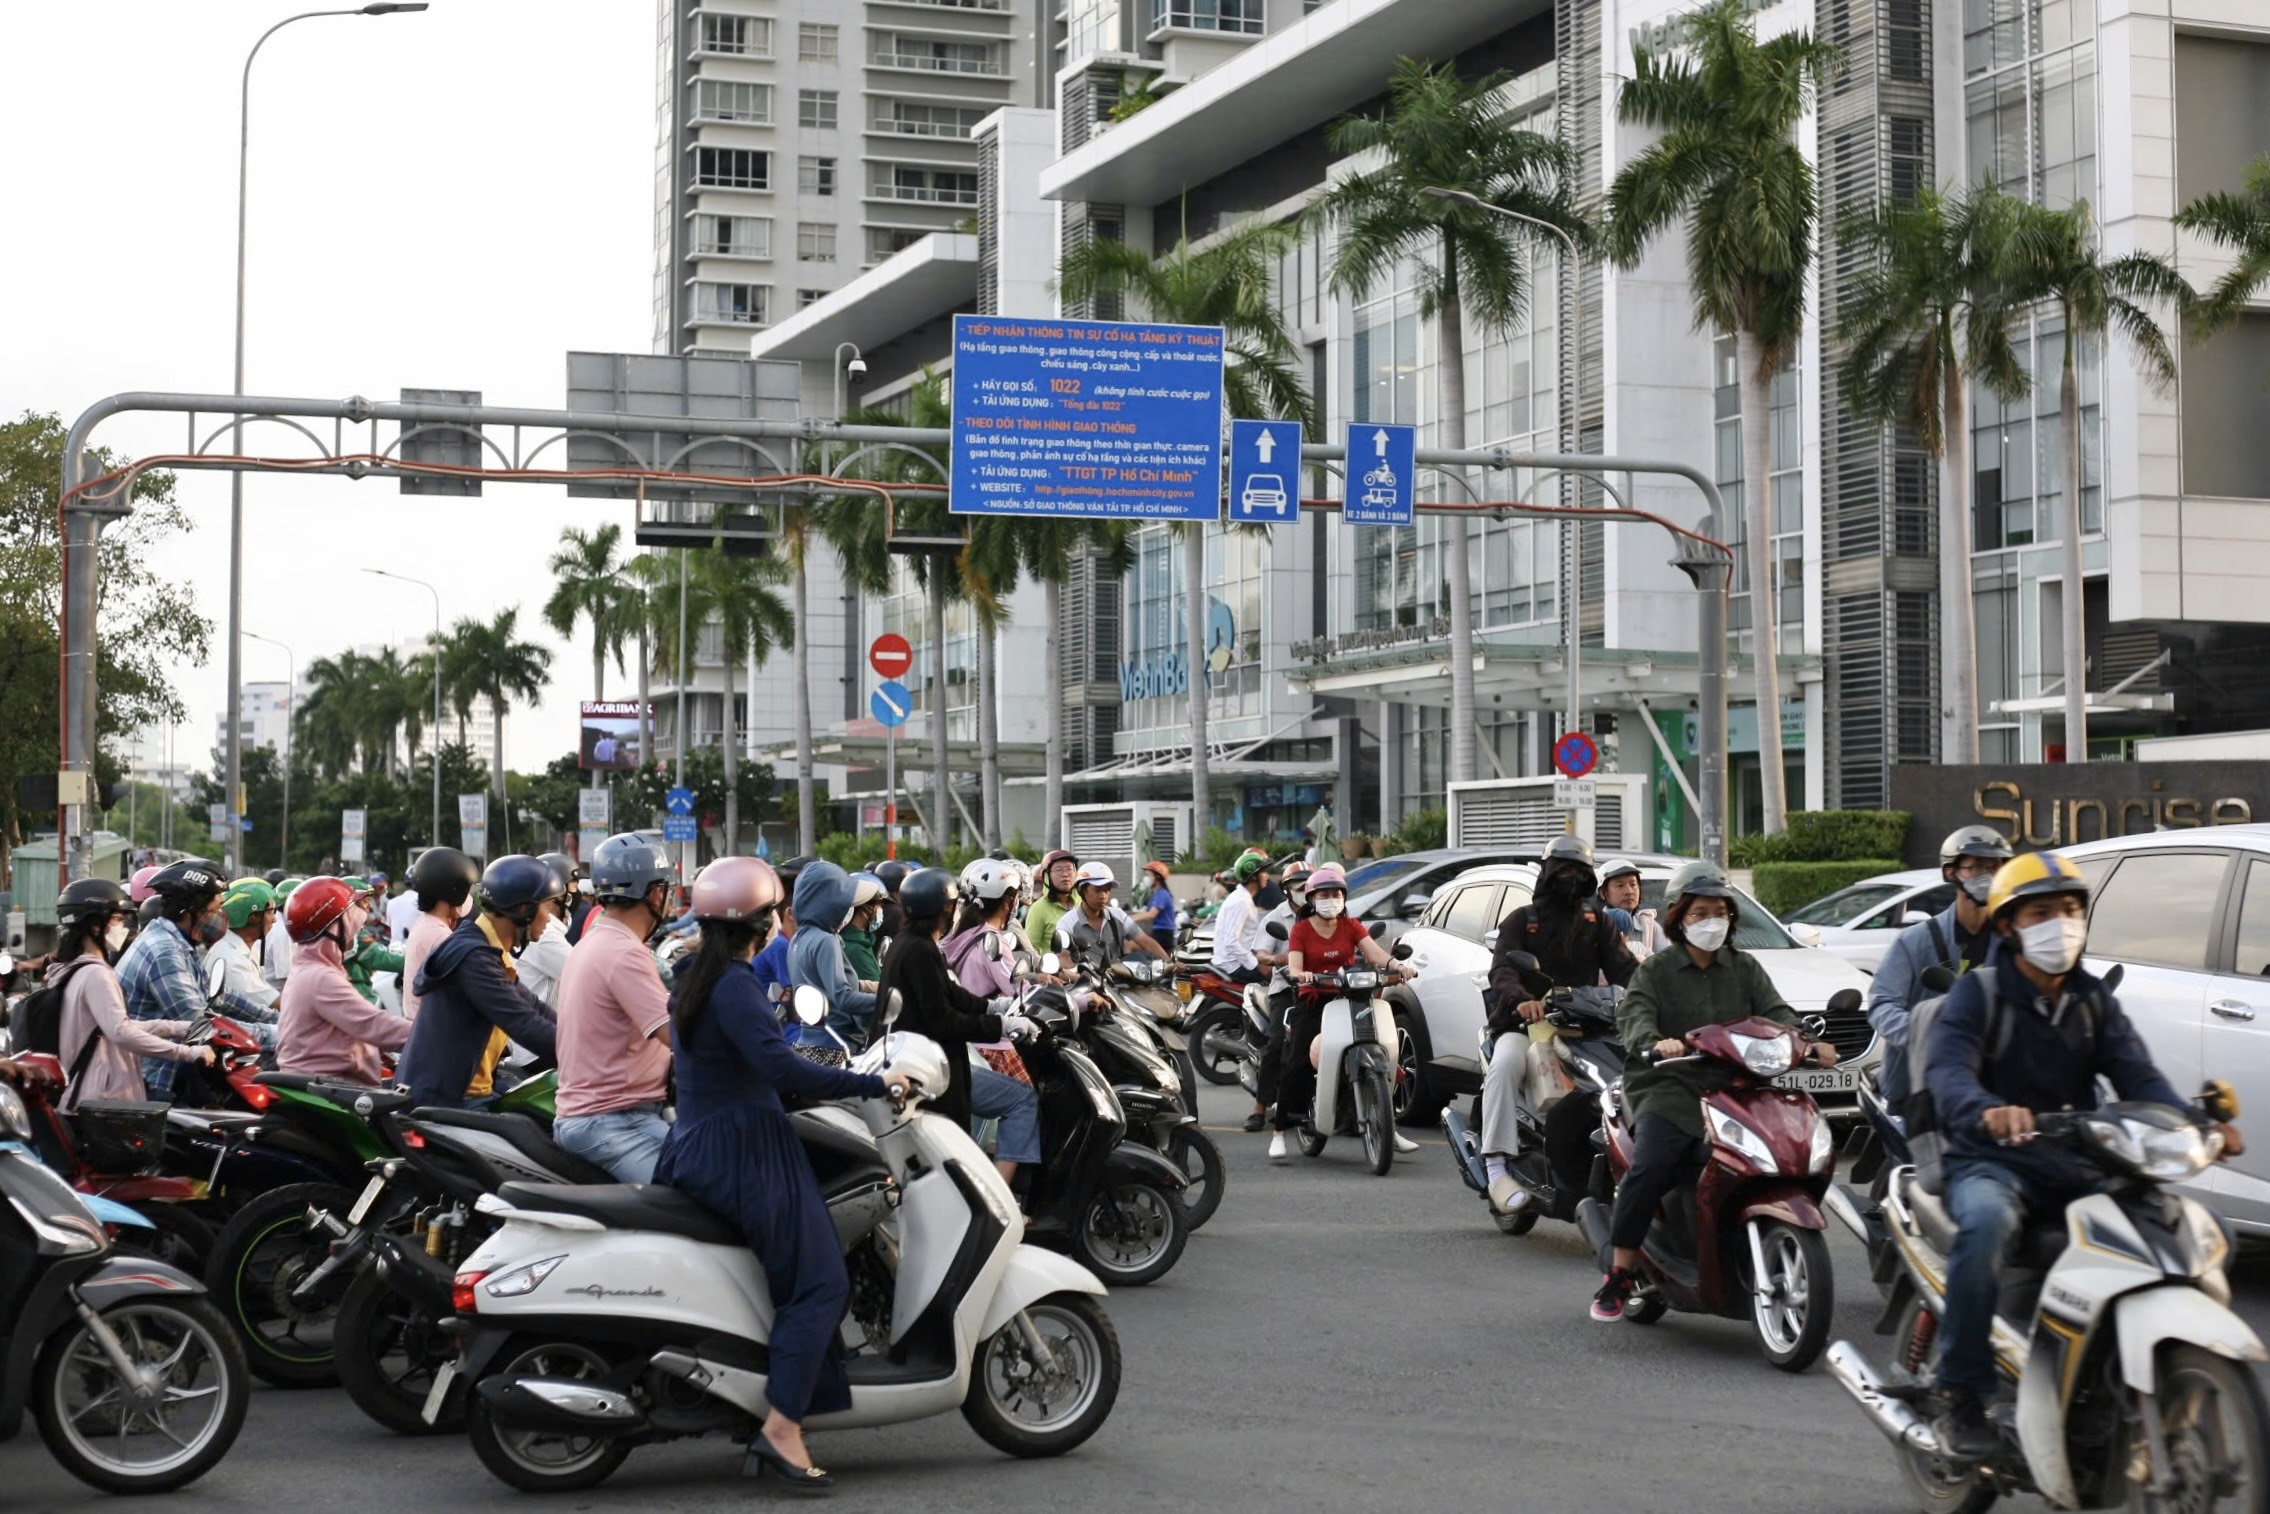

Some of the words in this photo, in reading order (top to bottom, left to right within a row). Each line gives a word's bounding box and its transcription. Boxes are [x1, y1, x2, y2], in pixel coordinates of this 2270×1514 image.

[967, 322, 991, 336] TIẾP
[993, 324, 1025, 339] NHẬN
[1028, 325, 1064, 339] THÔNG
[1067, 328, 1084, 340] TIN
[1087, 329, 1102, 342] SỰ
[1104, 326, 1119, 341] CỐ
[1186, 333, 1220, 348] THUẬT
[999, 345, 1018, 355] giao
[1049, 348, 1067, 357] giao
[1069, 346, 1094, 357] thông
[1096, 348, 1117, 359] công
[1162, 350, 1172, 360] và
[1173, 351, 1195, 361] thoát
[1041, 357, 1065, 368] chiếu
[1092, 360, 1107, 372] cây
[981, 378, 1001, 391] HÃY
[1003, 381, 1019, 393] GỌI
[1050, 378, 1081, 394] 1022
[1127, 386, 1145, 396] tính
[1170, 389, 1192, 400] cuộc
[982, 393, 997, 406] TẢI
[999, 394, 1020, 407] ỨNG
[965, 417, 993, 429] THEO
[996, 416, 1014, 429] DÕI
[1016, 416, 1042, 430] TÌNH
[1044, 418, 1070, 431] HÌNH
[1073, 421, 1098, 432] GIAO
[1100, 420, 1137, 434] THÔNG
[1020, 436, 1044, 448] trạng
[1046, 439, 1064, 449] giao
[1066, 438, 1091, 450] thông
[1093, 439, 1113, 449] theo
[1114, 440, 1131, 450] thời
[1133, 442, 1152, 451] gian
[1177, 444, 1210, 452] camera
[970, 449, 988, 460] giao
[1020, 449, 1042, 461] phản
[1044, 451, 1060, 460] ánh
[1088, 453, 1099, 463] hạ
[1122, 453, 1132, 463] và
[1133, 453, 1148, 463] các
[980, 463, 995, 476] TẢI
[997, 464, 1018, 477] ỨNG
[1100, 467, 1117, 480] TP
[1120, 467, 1137, 481] Hồ
[1140, 469, 1160, 481] Chí
[1036, 501, 1055, 510] GIAO
[1057, 499, 1085, 511] THÔNG
[1086, 501, 1104, 513] VẬN
[1106, 501, 1119, 512] TẢI
[1132, 501, 1144, 513] HỒ
[1145, 501, 1160, 513] CHÍ
[1161, 505, 1182, 514] MINH
[1356, 510, 1360, 519] 2
[1387, 511, 1391, 520] 3
[1118, 651, 1211, 701] VietinBak
[1974, 781, 2250, 846] Sunrise
